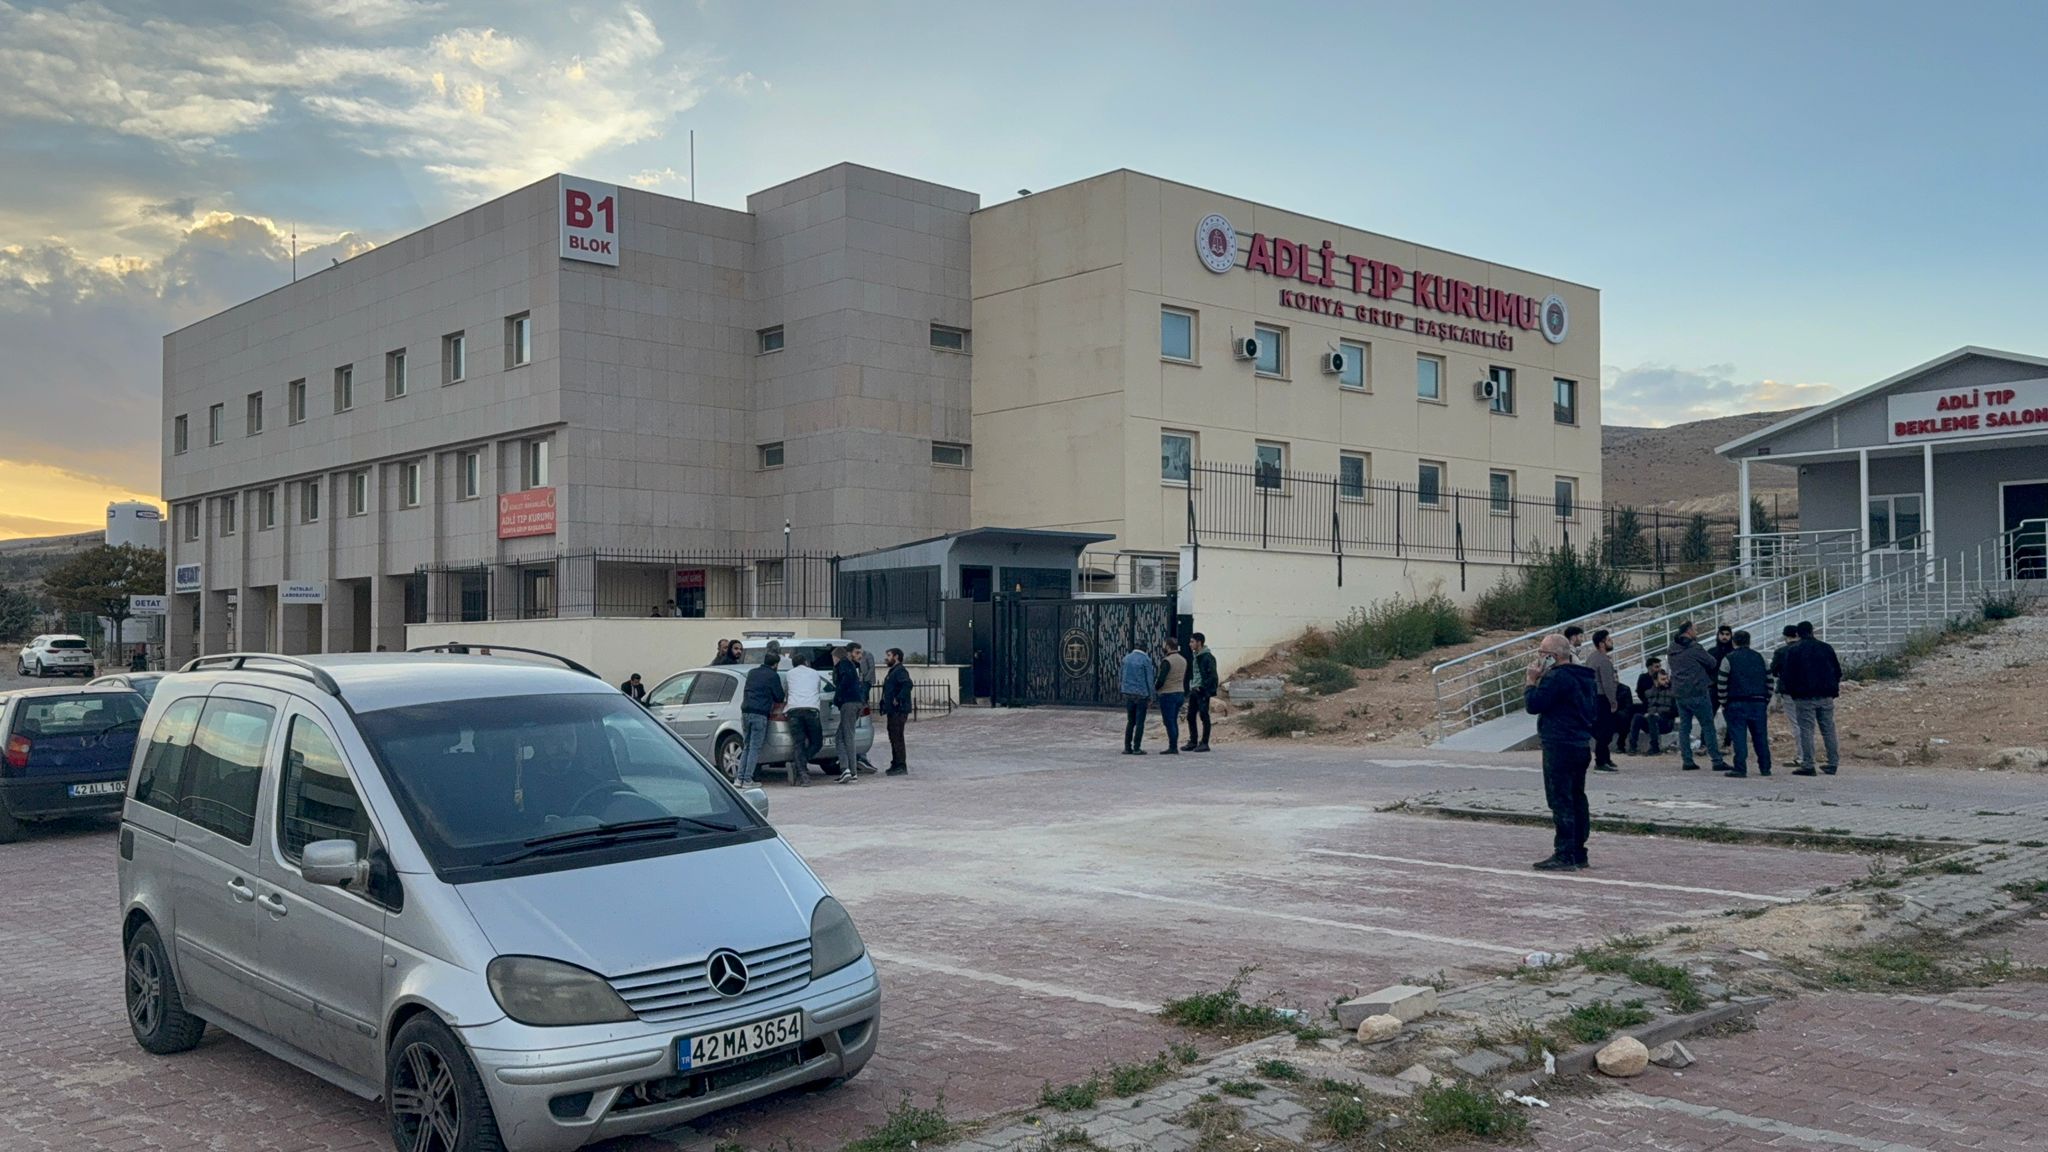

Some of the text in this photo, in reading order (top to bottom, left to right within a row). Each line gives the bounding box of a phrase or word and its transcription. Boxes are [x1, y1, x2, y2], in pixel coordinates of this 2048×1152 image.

[566, 188, 614, 233] B1
[569, 235, 612, 255] BLOK
[1247, 233, 1536, 331] ADLİ TIP KURUMU
[1281, 290, 1514, 351] KONYA GRUP BAŞKANLIĞI
[1937, 389, 2016, 411] ADLİ TIP
[1895, 415, 1979, 436] BEKLEME
[502, 512, 554, 525] ADLİ TIP KURUMU
[135, 599, 161, 607] GETAT
[75, 784, 87, 795] 42
[90, 782, 107, 793] ALL
[692, 1035, 719, 1062] 42
[723, 1029, 748, 1057] MA
[753, 1015, 799, 1049] 3654
[681, 1056, 690, 1064] TR
